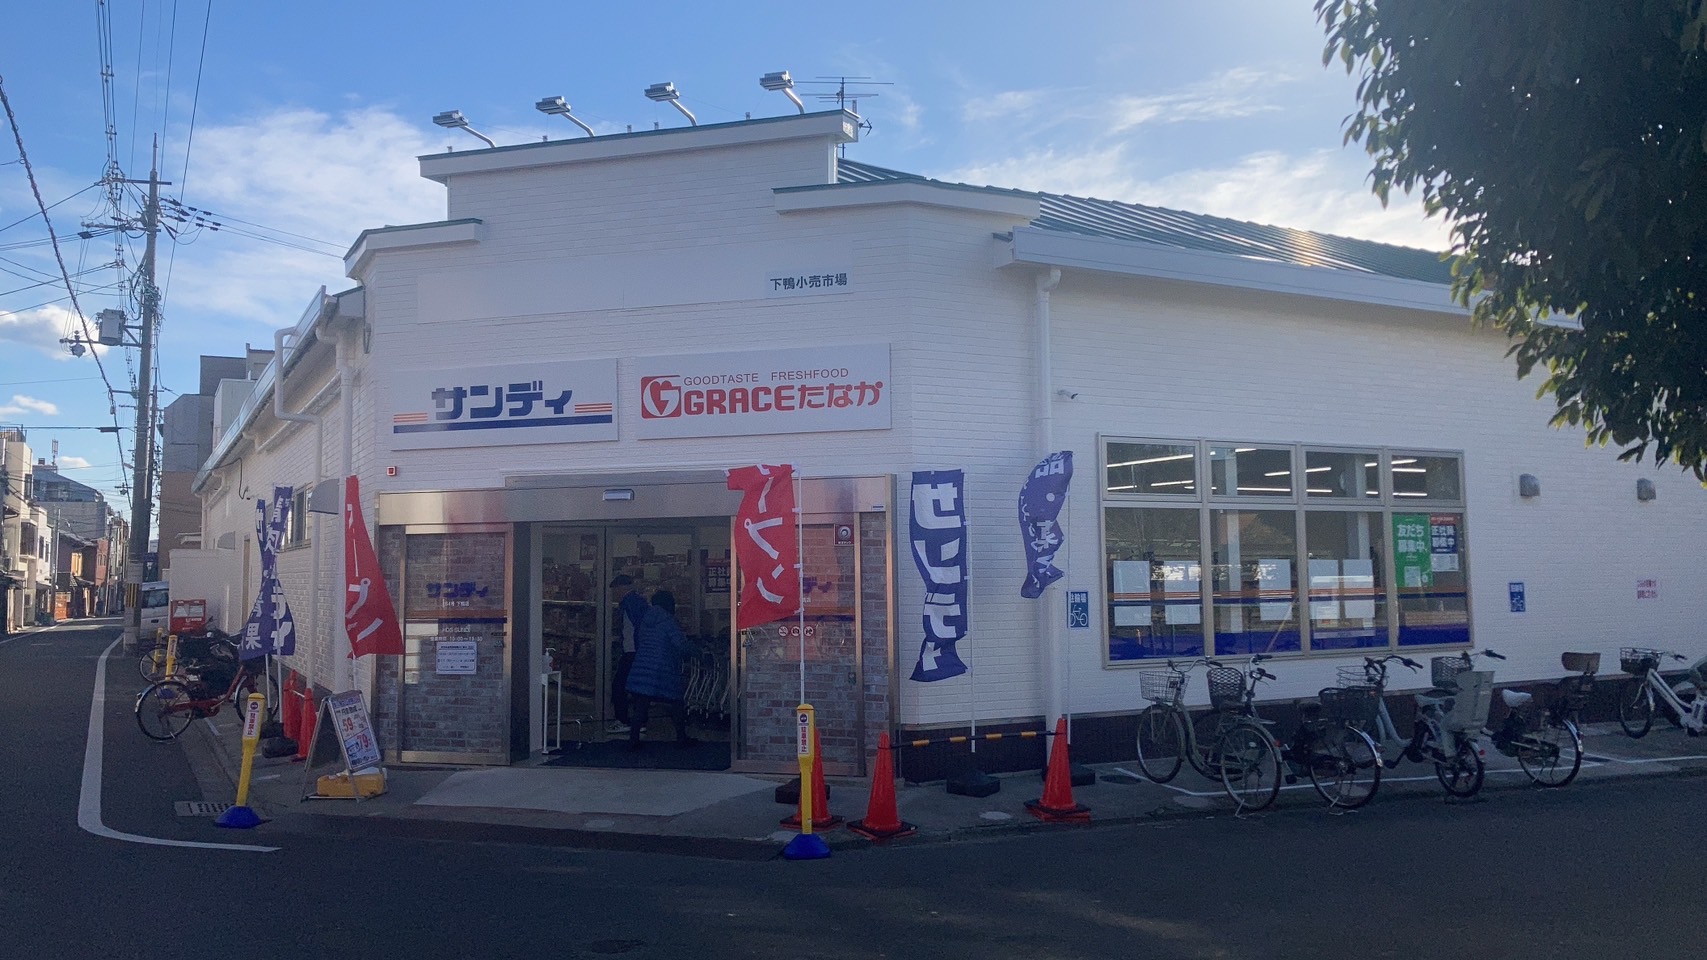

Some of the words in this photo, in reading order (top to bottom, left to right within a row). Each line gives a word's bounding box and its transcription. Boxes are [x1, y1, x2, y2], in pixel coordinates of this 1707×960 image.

[770, 273, 847, 291] 下鴨小売市場
[683, 373, 759, 385] GOODTASTE
[771, 368, 848, 382] FRESHFOOD
[431, 381, 573, 420] サンディ
